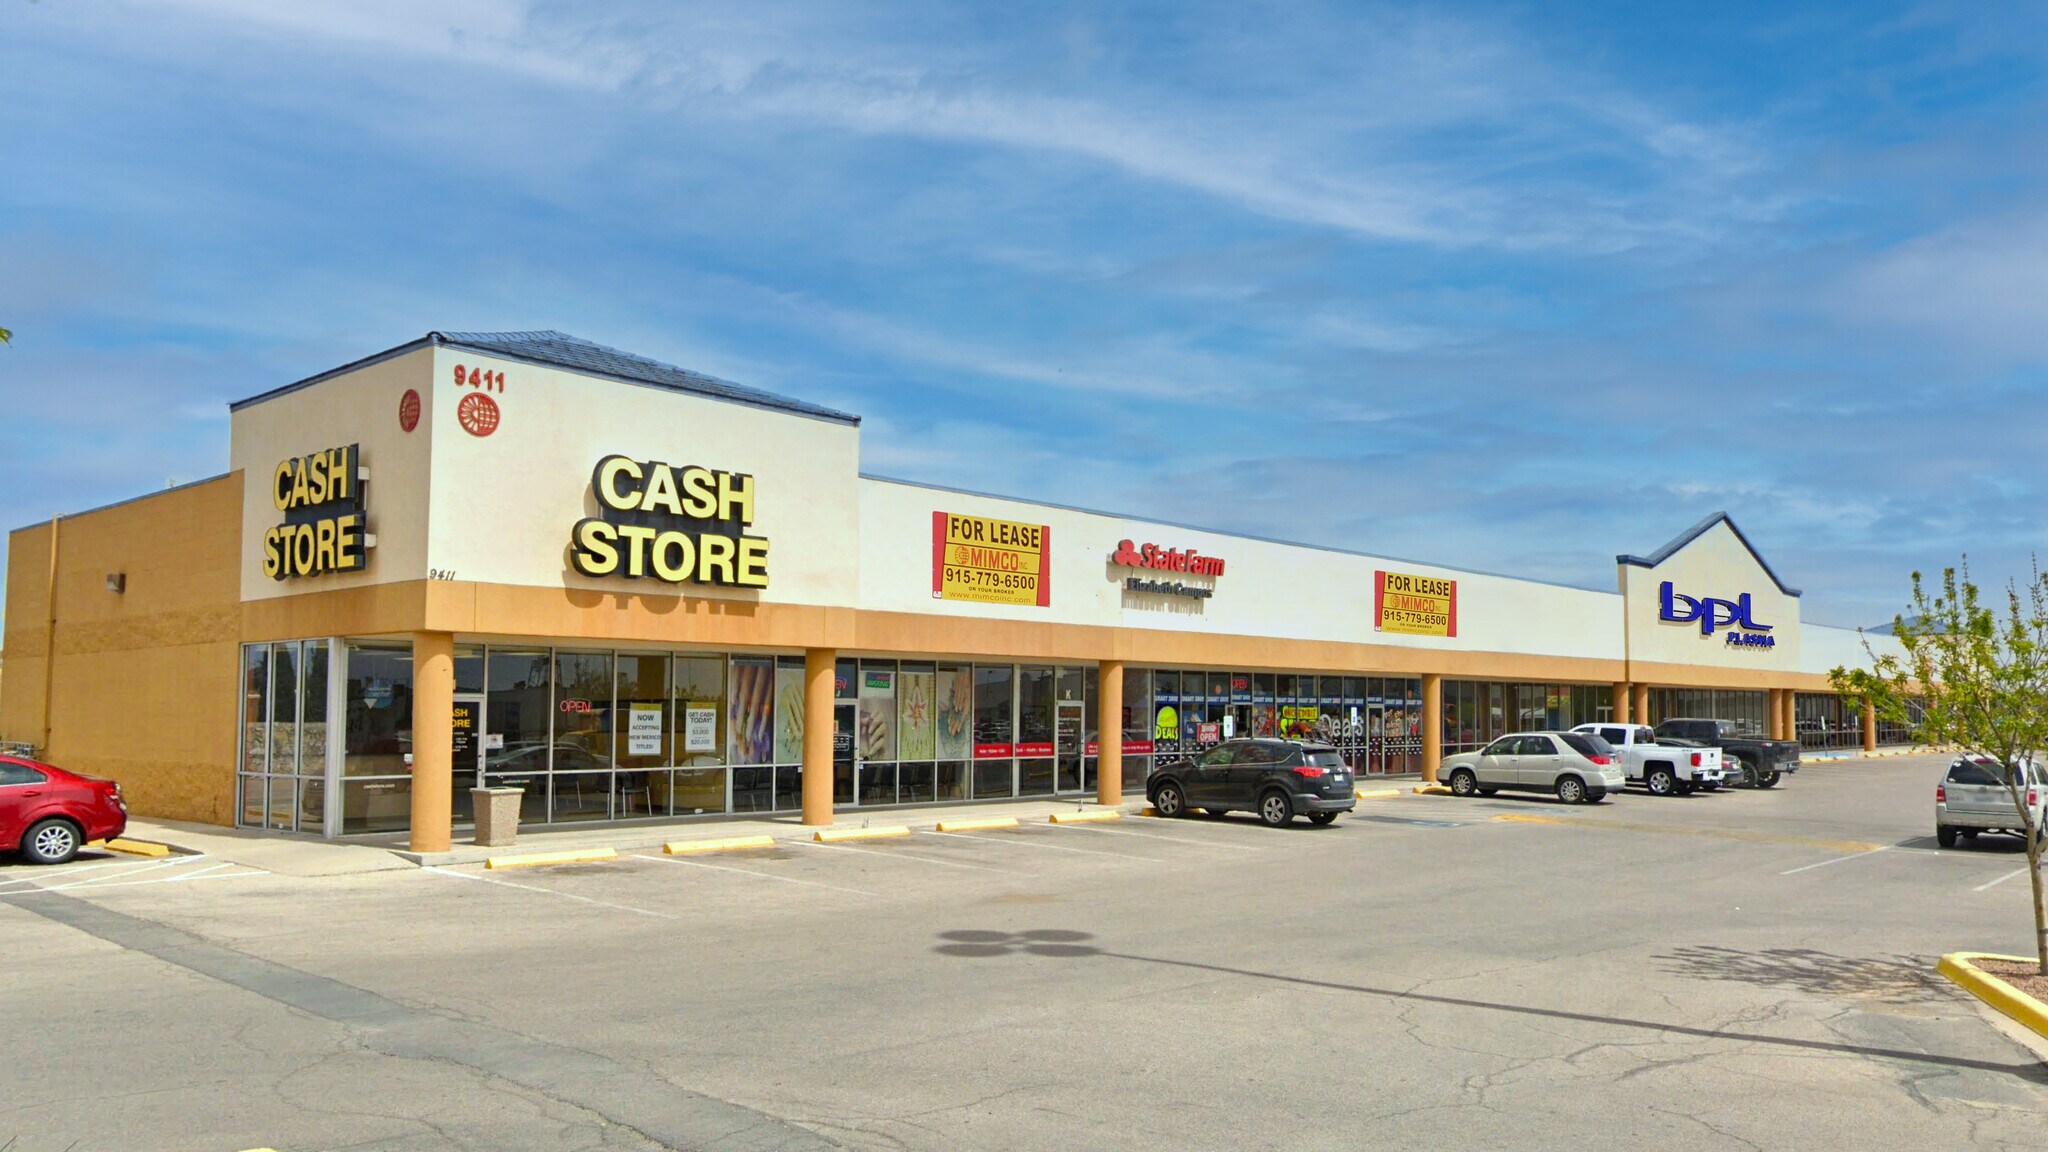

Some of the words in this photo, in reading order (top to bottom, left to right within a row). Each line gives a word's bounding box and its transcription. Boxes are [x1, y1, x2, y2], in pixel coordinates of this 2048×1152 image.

[454, 364, 505, 393] 9411
[273, 447, 349, 511] CASH
[593, 454, 755, 527] CASH
[951, 517, 984, 542] FOR
[990, 522, 1039, 548] LEASE
[263, 514, 356, 578] STORE
[571, 517, 770, 589] STORE
[970, 547, 1019, 571] MIMCO
[430, 568, 456, 581] 9411
[945, 568, 1035, 590] 915-779-6500
[1387, 575, 1411, 591] FOR
[1415, 578, 1449, 596] LEASE
[948, 591, 1031, 604] www.mimcoinc.com
[1401, 596, 1435, 613] MIMCO
[1384, 610, 1446, 625] 915-779-6500
[1727, 632, 1775, 648] PLASMA
[1065, 689, 1071, 700] K
[560, 700, 591, 713] OPEN
[1155, 726, 1178, 740] DEALS
[1200, 733, 1217, 741] OPEN
